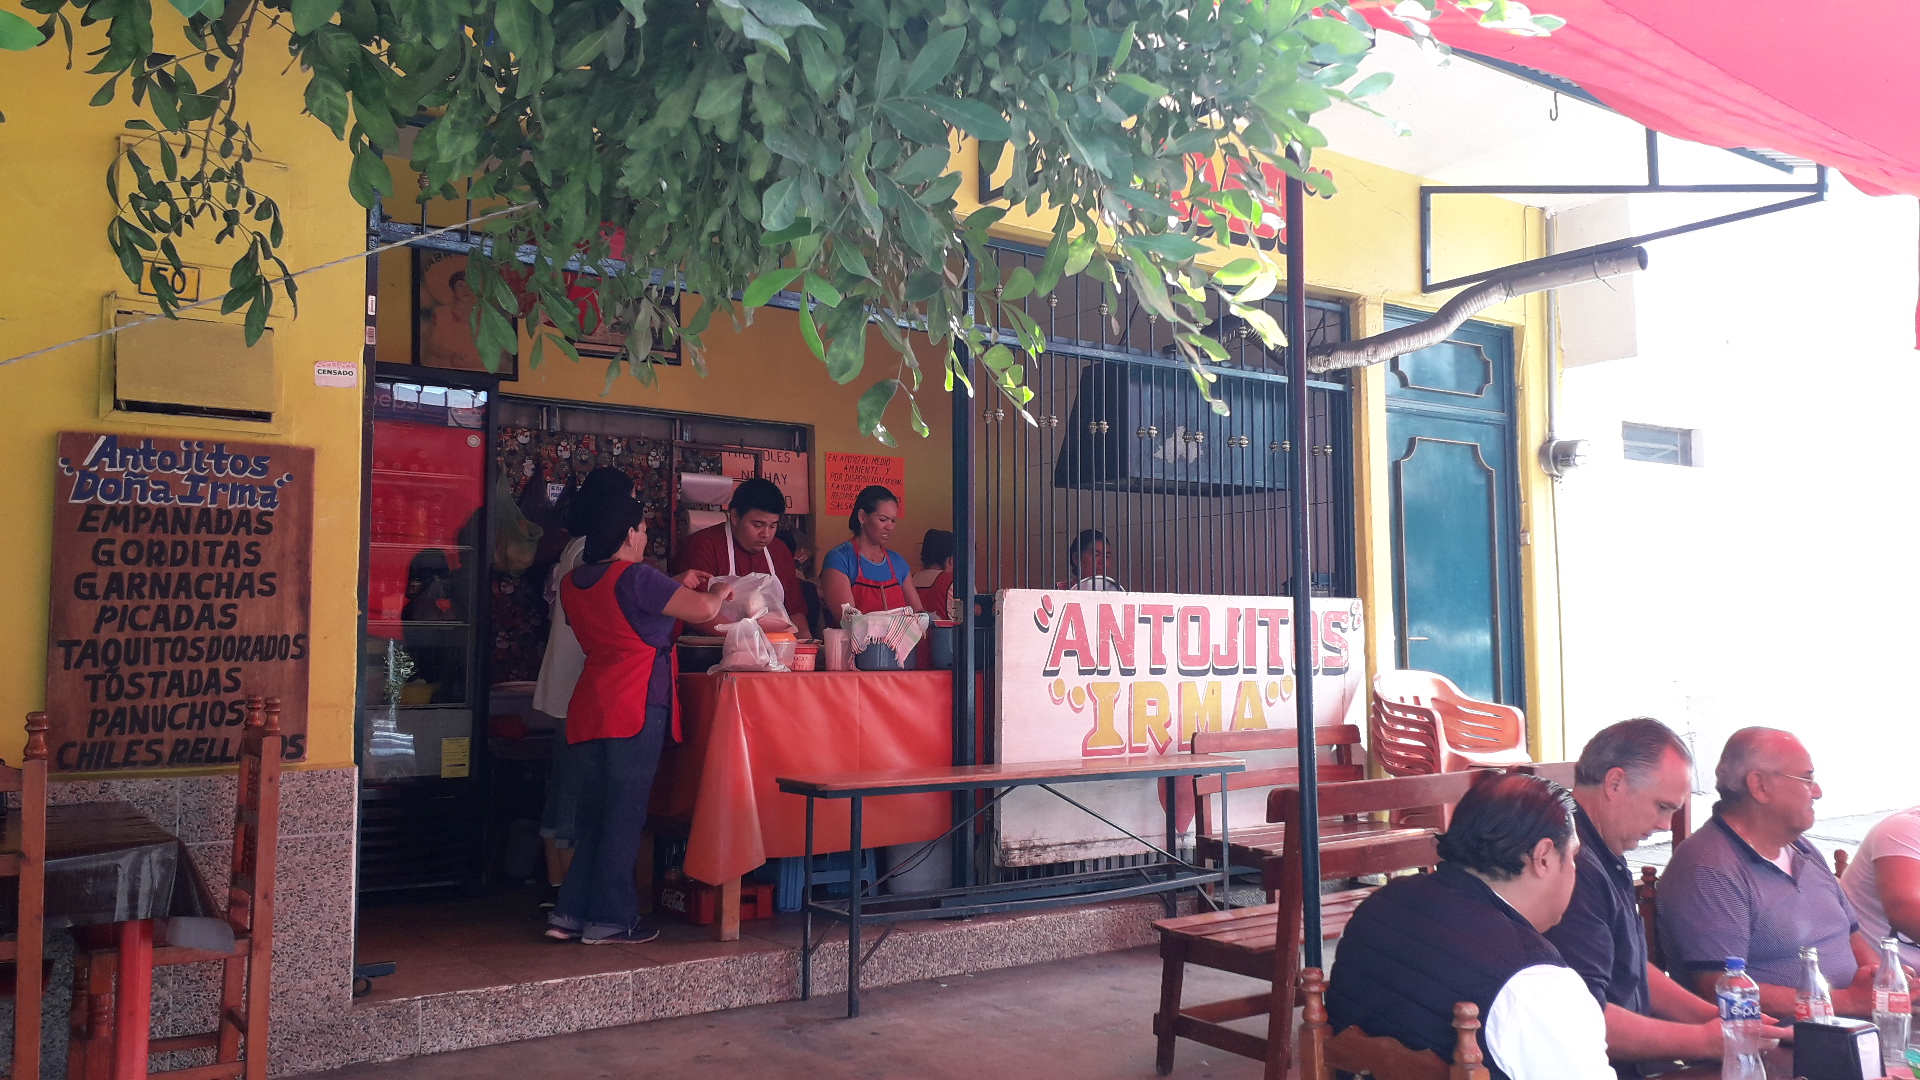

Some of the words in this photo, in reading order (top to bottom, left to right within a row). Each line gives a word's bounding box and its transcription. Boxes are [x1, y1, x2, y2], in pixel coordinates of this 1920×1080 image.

[317, 368, 354, 377] CENSADO
[83, 435, 271, 478] Antojitos
[828, 453, 837, 462] EN
[840, 455, 861, 464] APOYO
[861, 457, 869, 465] AL
[872, 457, 891, 466] MEDIO
[844, 464, 879, 474] AMBIENTE
[886, 467, 891, 475] Y
[764, 472, 788, 485] HAY
[830, 472, 843, 481] POR
[77, 504, 274, 536] EMPANADAS
[91, 537, 262, 568] GORDITAS
[74, 571, 277, 600] GARNACHAS
[93, 603, 238, 634] PICADAS
[85, 668, 242, 702] TOSTADAS
[87, 700, 245, 738] PANUCHOS
[57, 738, 165, 771] CHILES
